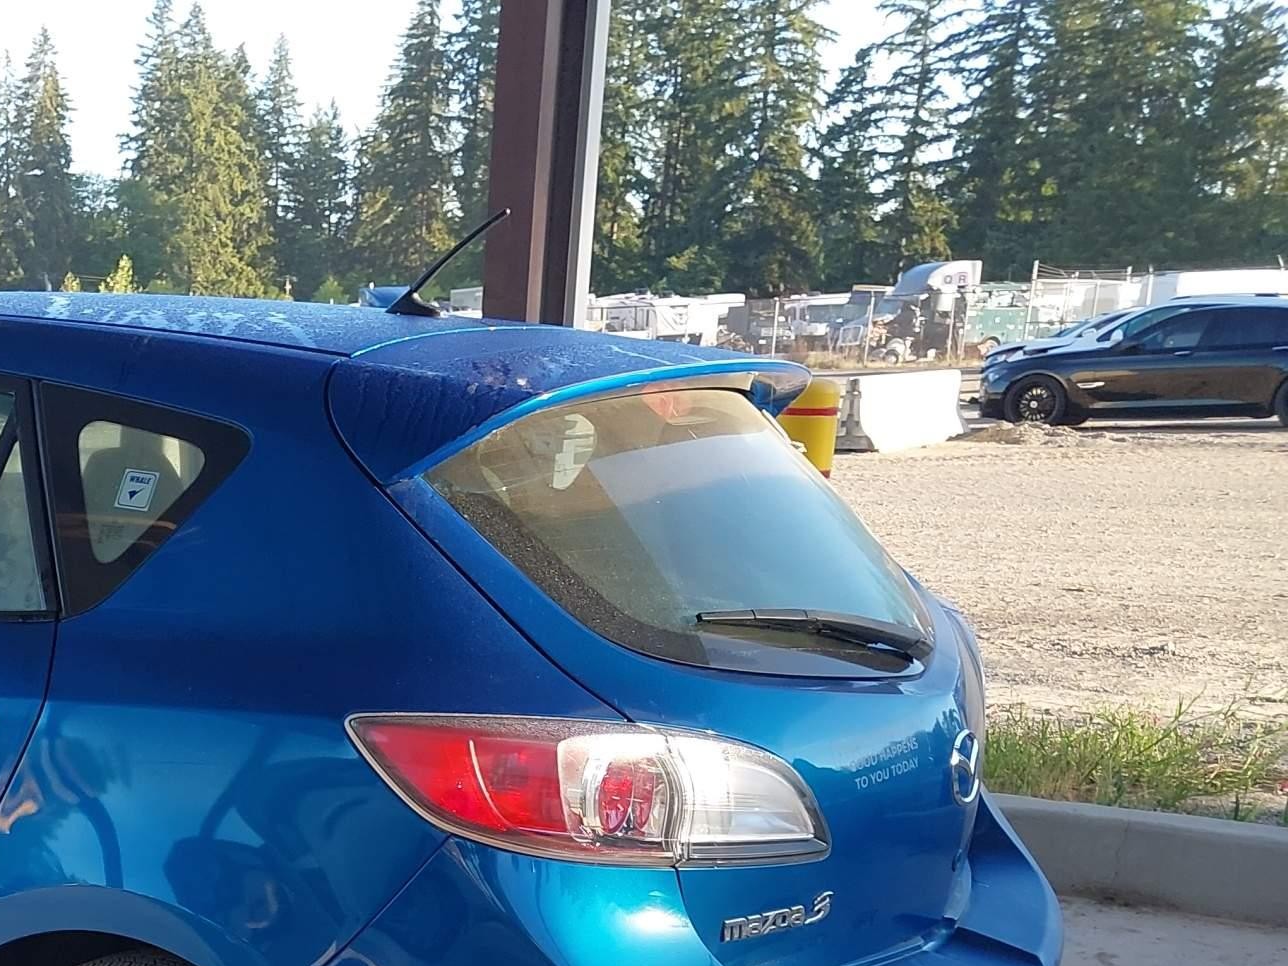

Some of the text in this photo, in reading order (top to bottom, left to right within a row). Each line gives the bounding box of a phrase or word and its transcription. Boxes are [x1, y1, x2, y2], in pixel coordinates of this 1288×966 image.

[878, 737, 919, 761] HAPPENS
[854, 755, 919, 790] TO YOU TODAY
